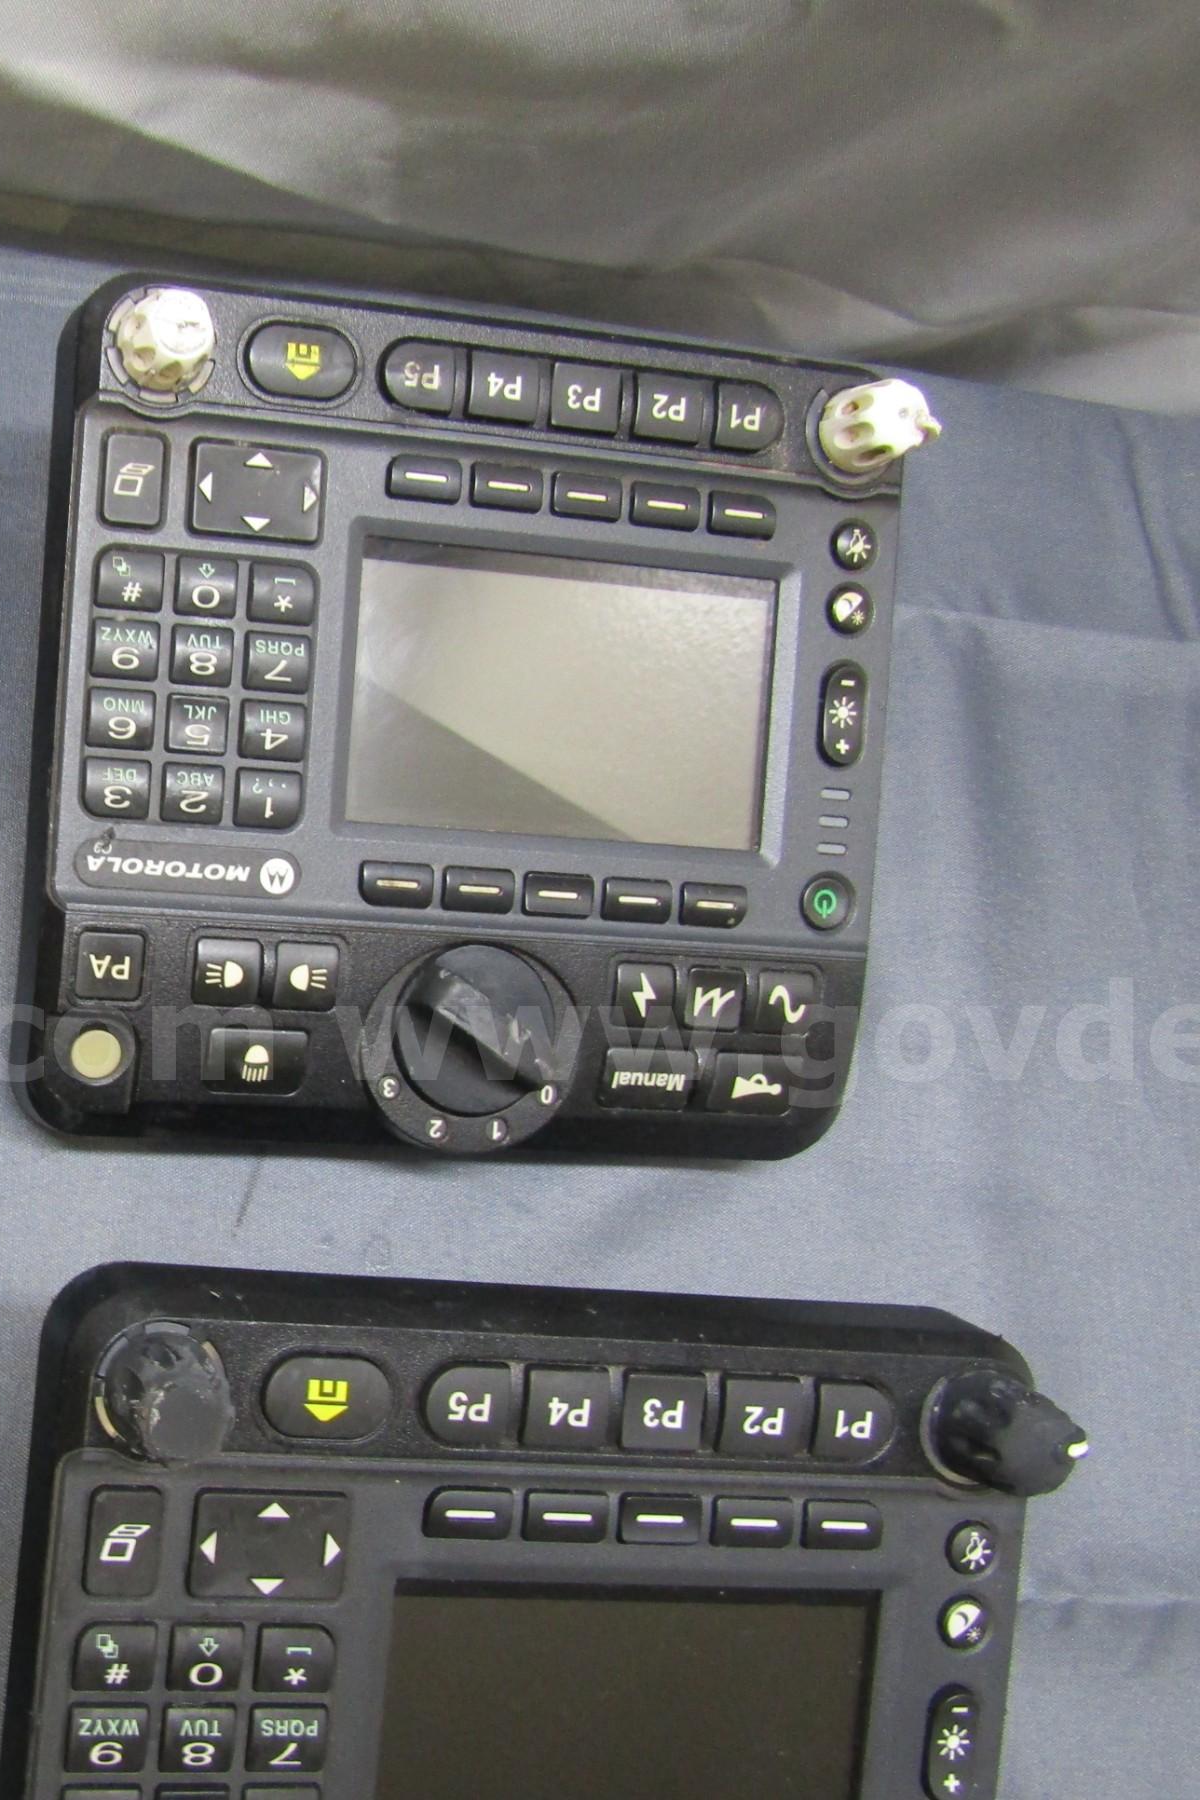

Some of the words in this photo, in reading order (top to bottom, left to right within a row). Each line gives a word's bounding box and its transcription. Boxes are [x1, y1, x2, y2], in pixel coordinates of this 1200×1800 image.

[403, 361, 440, 390] P5
[487, 372, 522, 401] P4
[567, 384, 601, 412] P3
[651, 393, 686, 422] P2
[729, 404, 761, 432] P1
[101, 626, 153, 645] WXYZ
[187, 633, 221, 649] TUV
[112, 646, 140, 670] 9
[255, 639, 305, 657] PQRS
[190, 652, 218, 676] 8
[264, 660, 292, 683] 7
[103, 698, 145, 713] MNO
[184, 704, 217, 720] JKL
[260, 709, 291, 725] GHI
[108, 716, 137, 740] 6
[184, 724, 211, 746] 5
[260, 728, 289, 750] 4
[102, 767, 137, 783] DEF
[176, 771, 214, 786] ABC
[103, 785, 132, 809] 3
[179, 790, 210, 813] 2
[264, 797, 274, 819] 1
[86, 855, 251, 882] MOTOROLA
[89, 954, 131, 980] PA
[382, 1078, 394, 1098] 3
[612, 1071, 686, 1092] Manual
[540, 1085, 553, 1105] 0
[428, 1120, 442, 1138] 2
[491, 1121, 503, 1138] 1
[448, 1391, 491, 1422] P5
[548, 1396, 591, 1428] P4
[642, 1398, 685, 1429] P3
[743, 1406, 785, 1435] P2
[834, 1409, 873, 1439] P1
[79, 1719, 140, 1736] WXYZ
[180, 1719, 222, 1737] TUV
[261, 1719, 319, 1737] PQRS
[89, 1741, 124, 1765] 9
[181, 1742, 215, 1766] 8
[269, 1742, 302, 1765] 7
